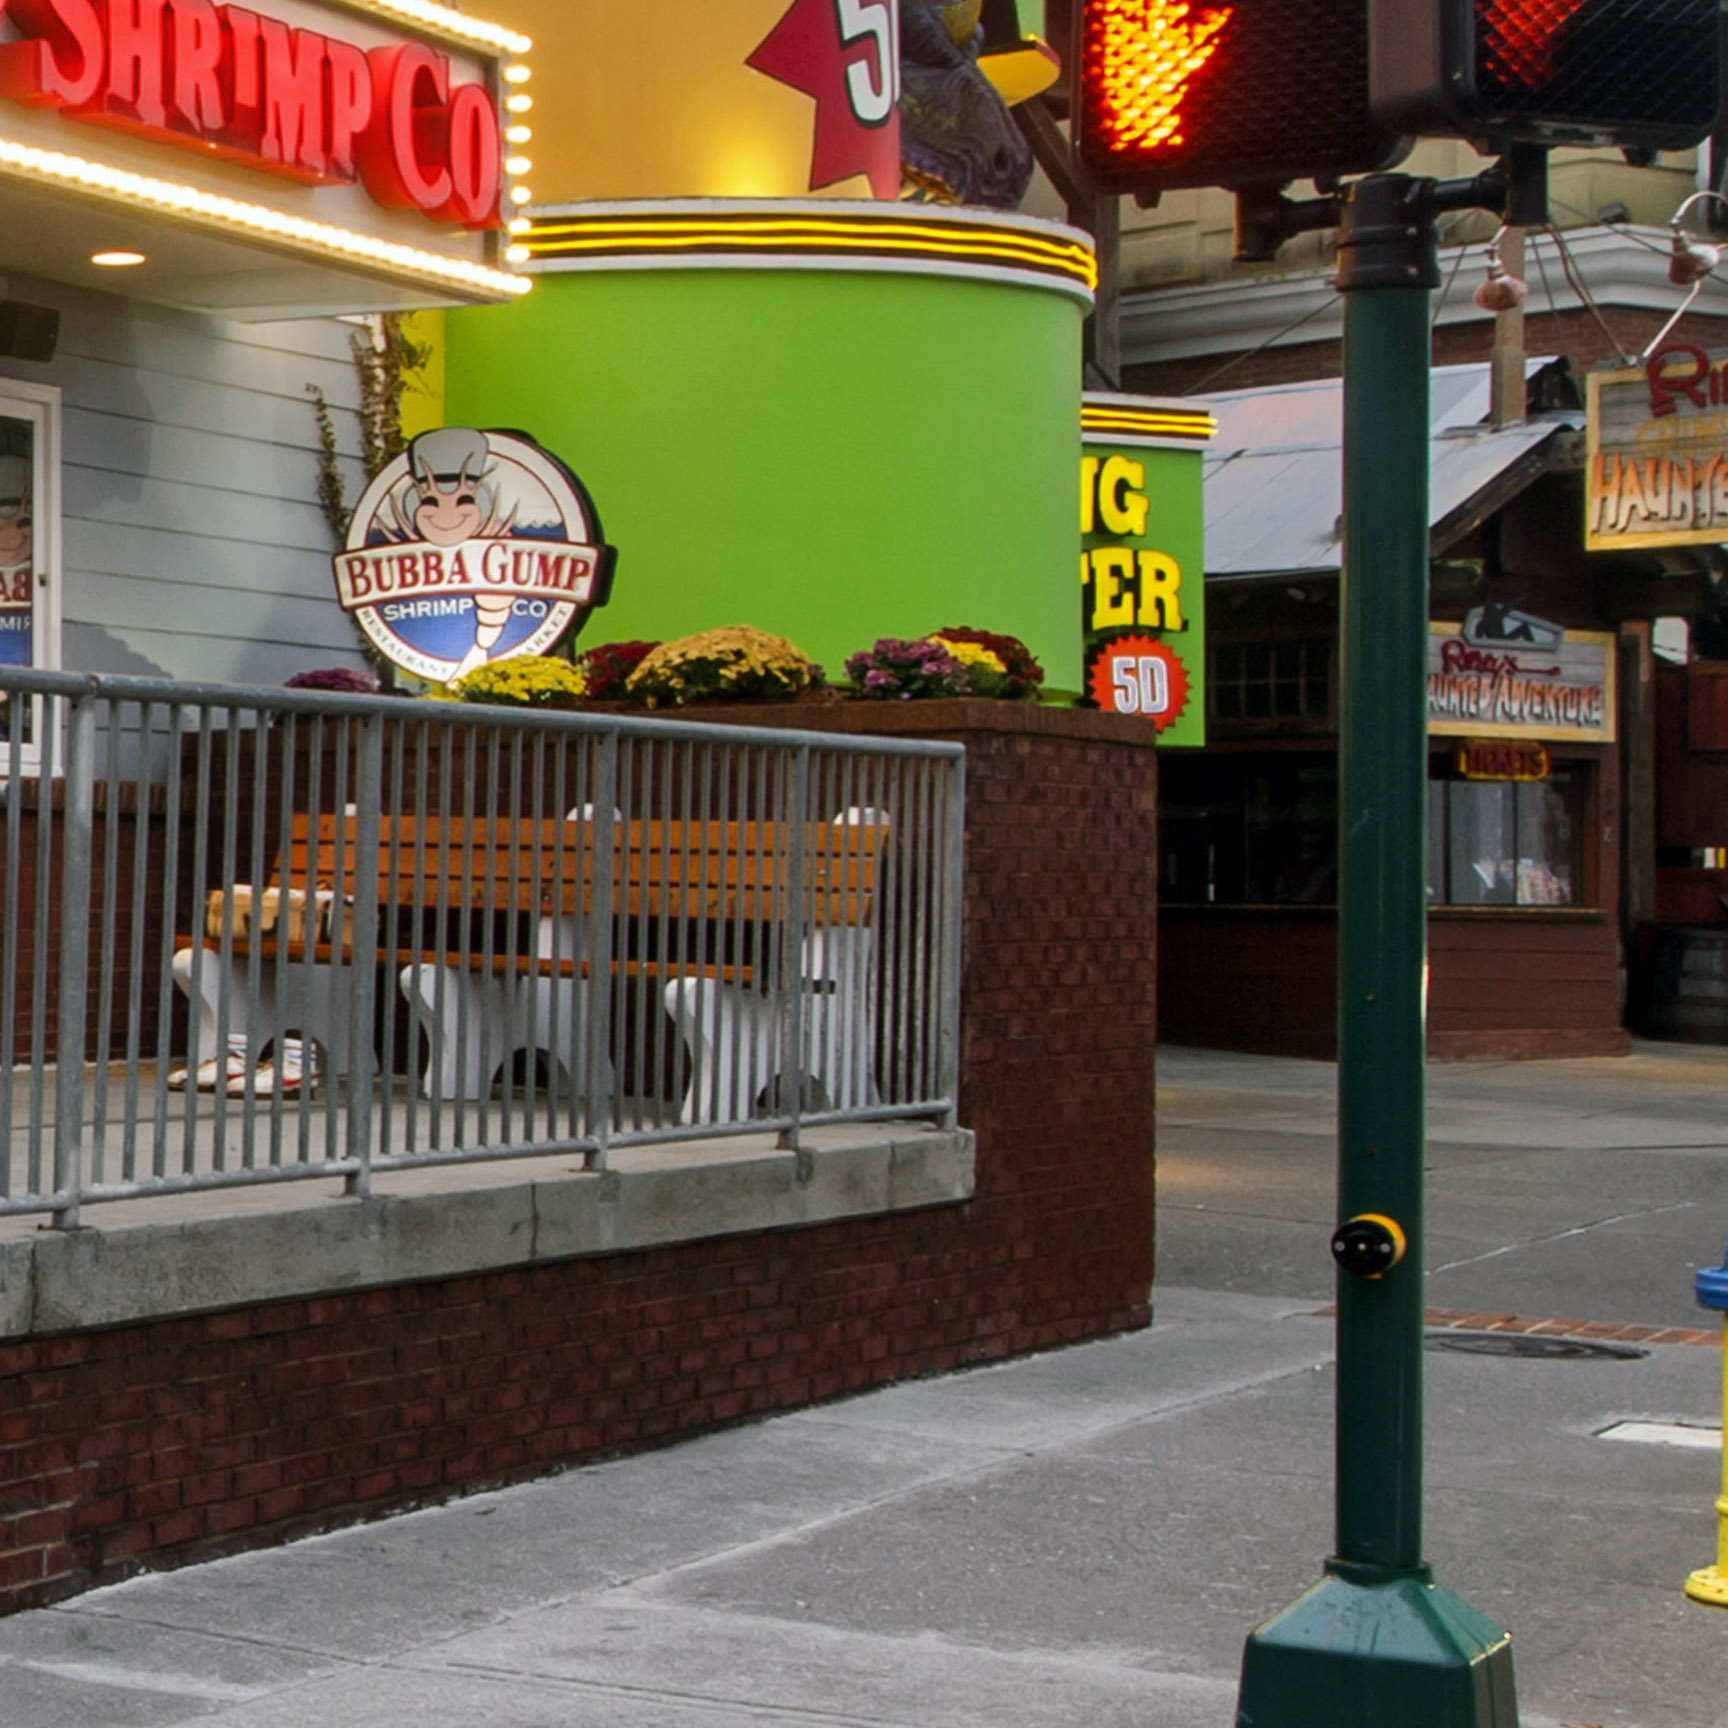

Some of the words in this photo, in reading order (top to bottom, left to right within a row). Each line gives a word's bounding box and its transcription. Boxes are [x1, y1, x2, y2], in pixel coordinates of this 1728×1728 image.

[345, 549, 471, 598] BUBBA
[481, 542, 592, 591] GUMP
[383, 597, 474, 622] SHRIMP
[511, 598, 547, 618] CO
[1111, 656, 1170, 714] 5D
